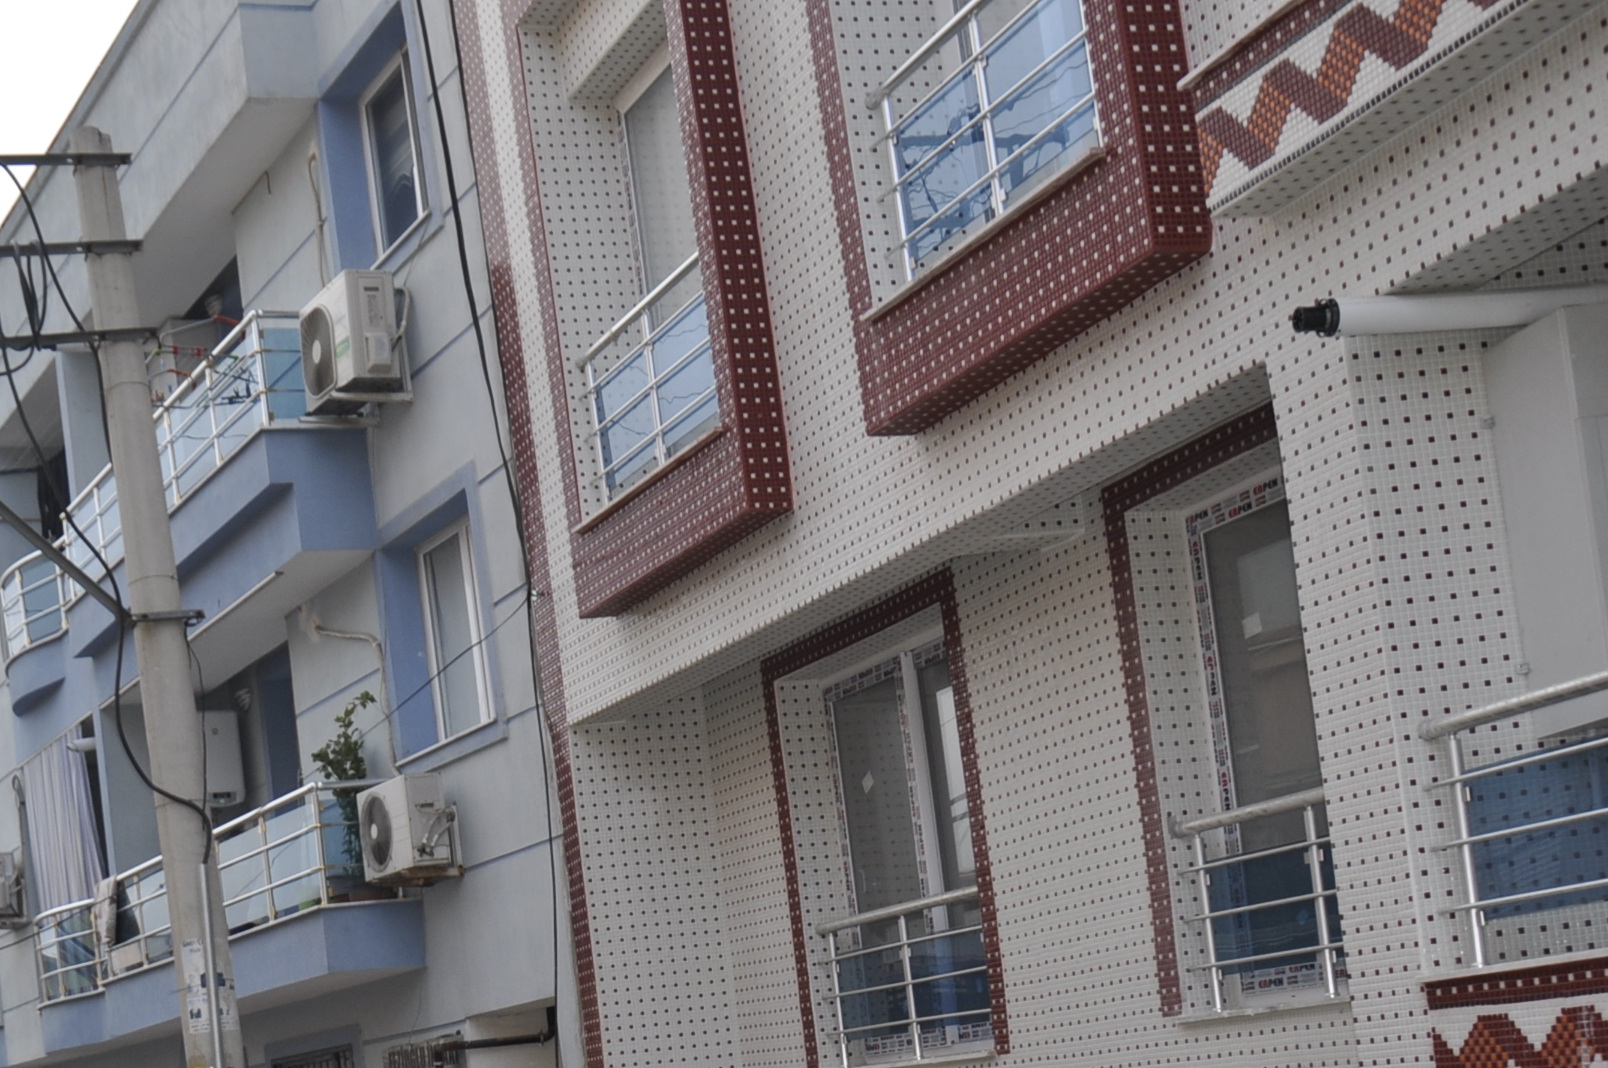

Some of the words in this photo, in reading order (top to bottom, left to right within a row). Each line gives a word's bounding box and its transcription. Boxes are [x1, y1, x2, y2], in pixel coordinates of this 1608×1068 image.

[1253, 477, 1278, 496] ERPEN
[1228, 501, 1253, 518] ERPEN
[1259, 977, 1284, 989] ERPEN
